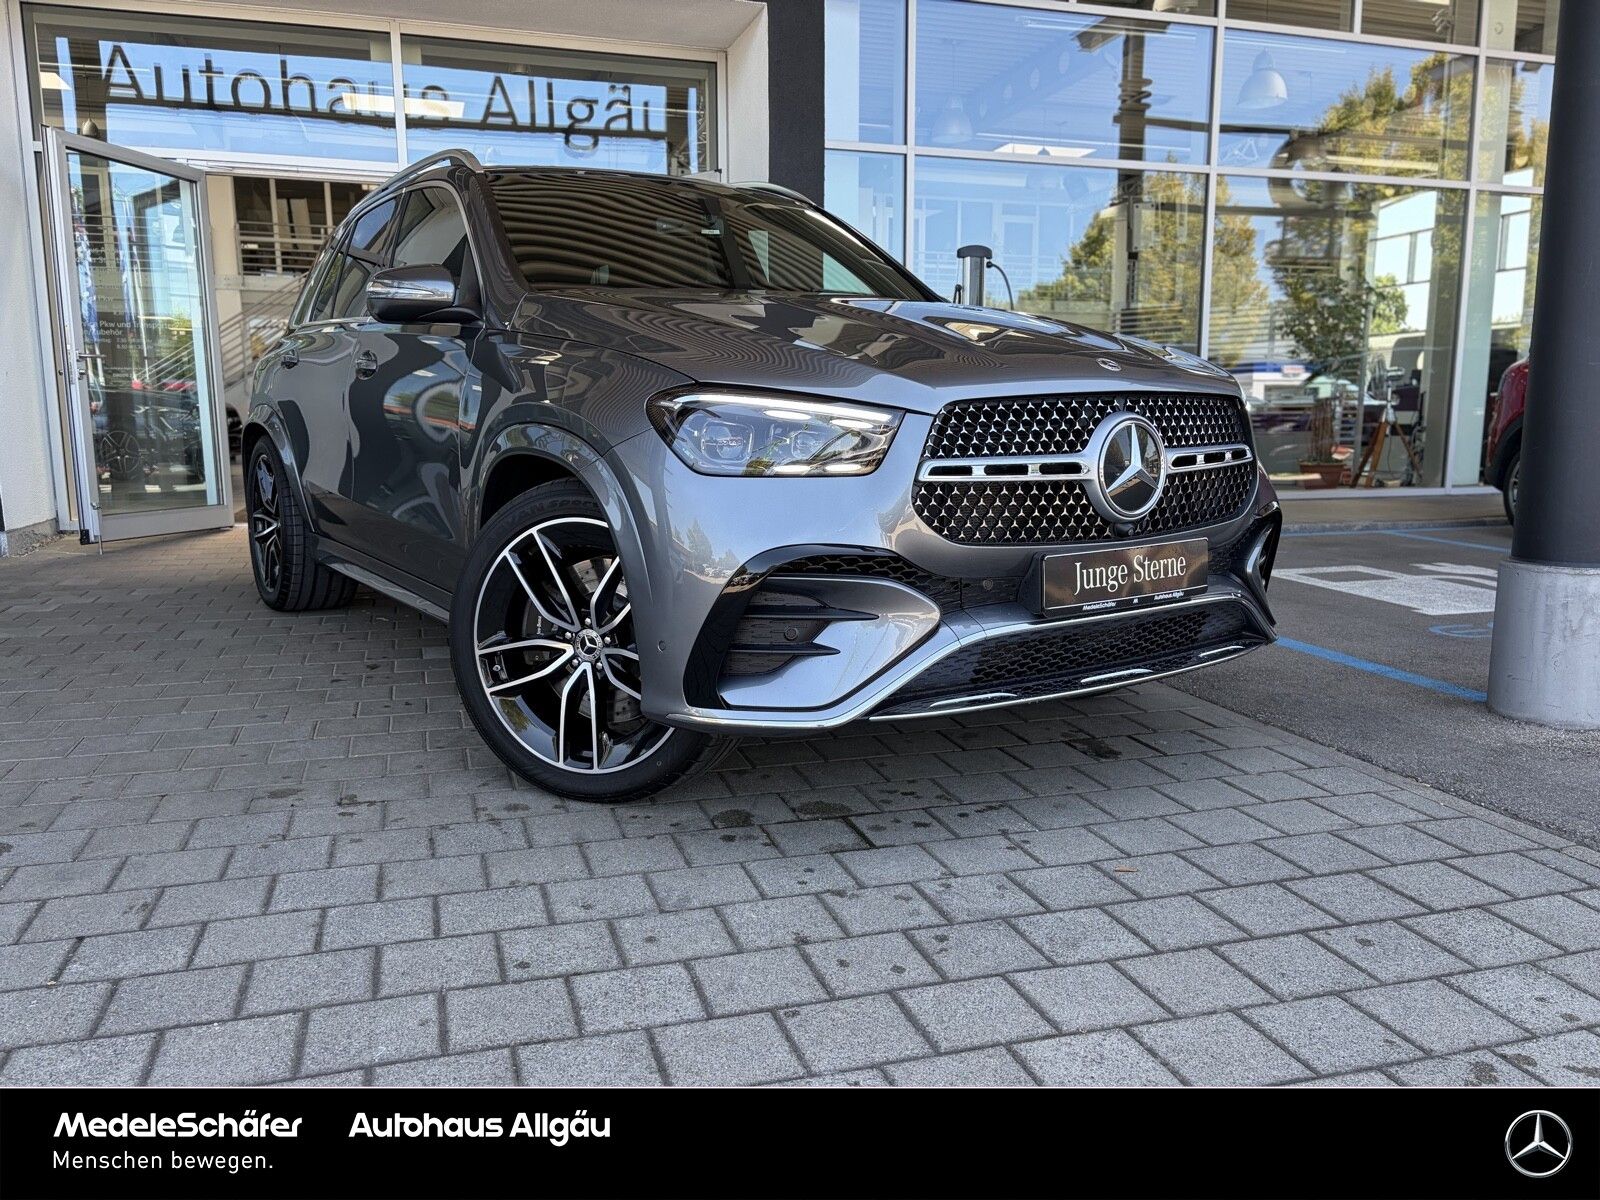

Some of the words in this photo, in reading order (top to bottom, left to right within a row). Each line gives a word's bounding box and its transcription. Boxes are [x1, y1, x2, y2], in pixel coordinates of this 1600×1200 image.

[103, 44, 449, 123] Autohaus
[99, 320, 115, 328] Pkw
[1074, 561, 1128, 596] Junge
[1133, 555, 1187, 583] Sterne
